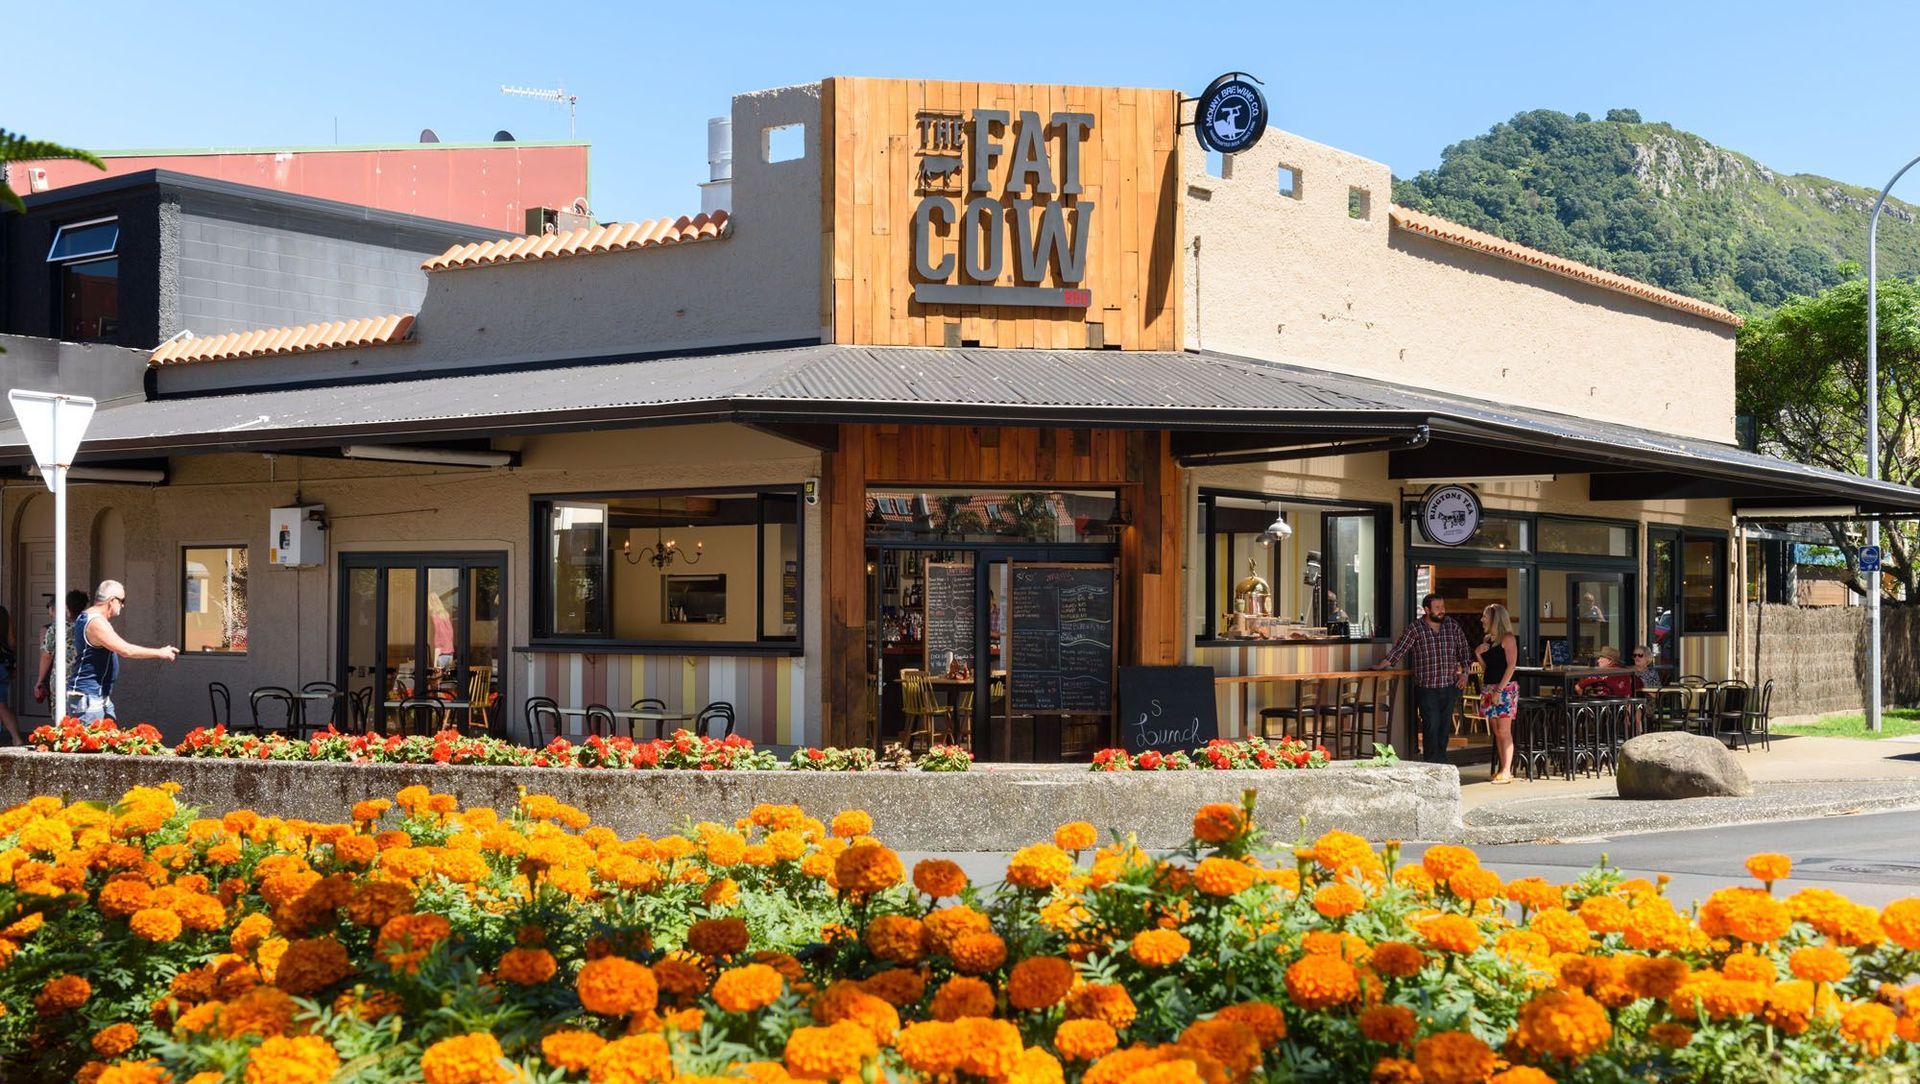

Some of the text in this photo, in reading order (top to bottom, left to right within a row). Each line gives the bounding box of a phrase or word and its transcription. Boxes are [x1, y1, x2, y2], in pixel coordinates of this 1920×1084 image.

[1206, 95, 1221, 126] MOUNT
[1221, 86, 1255, 102] BREWING
[918, 116, 966, 146] THE
[972, 108, 1095, 194] FAT
[915, 196, 1095, 283] COW
[1430, 493, 1473, 520] RINGTONS TEA
[1130, 712, 1208, 748] Lunch
